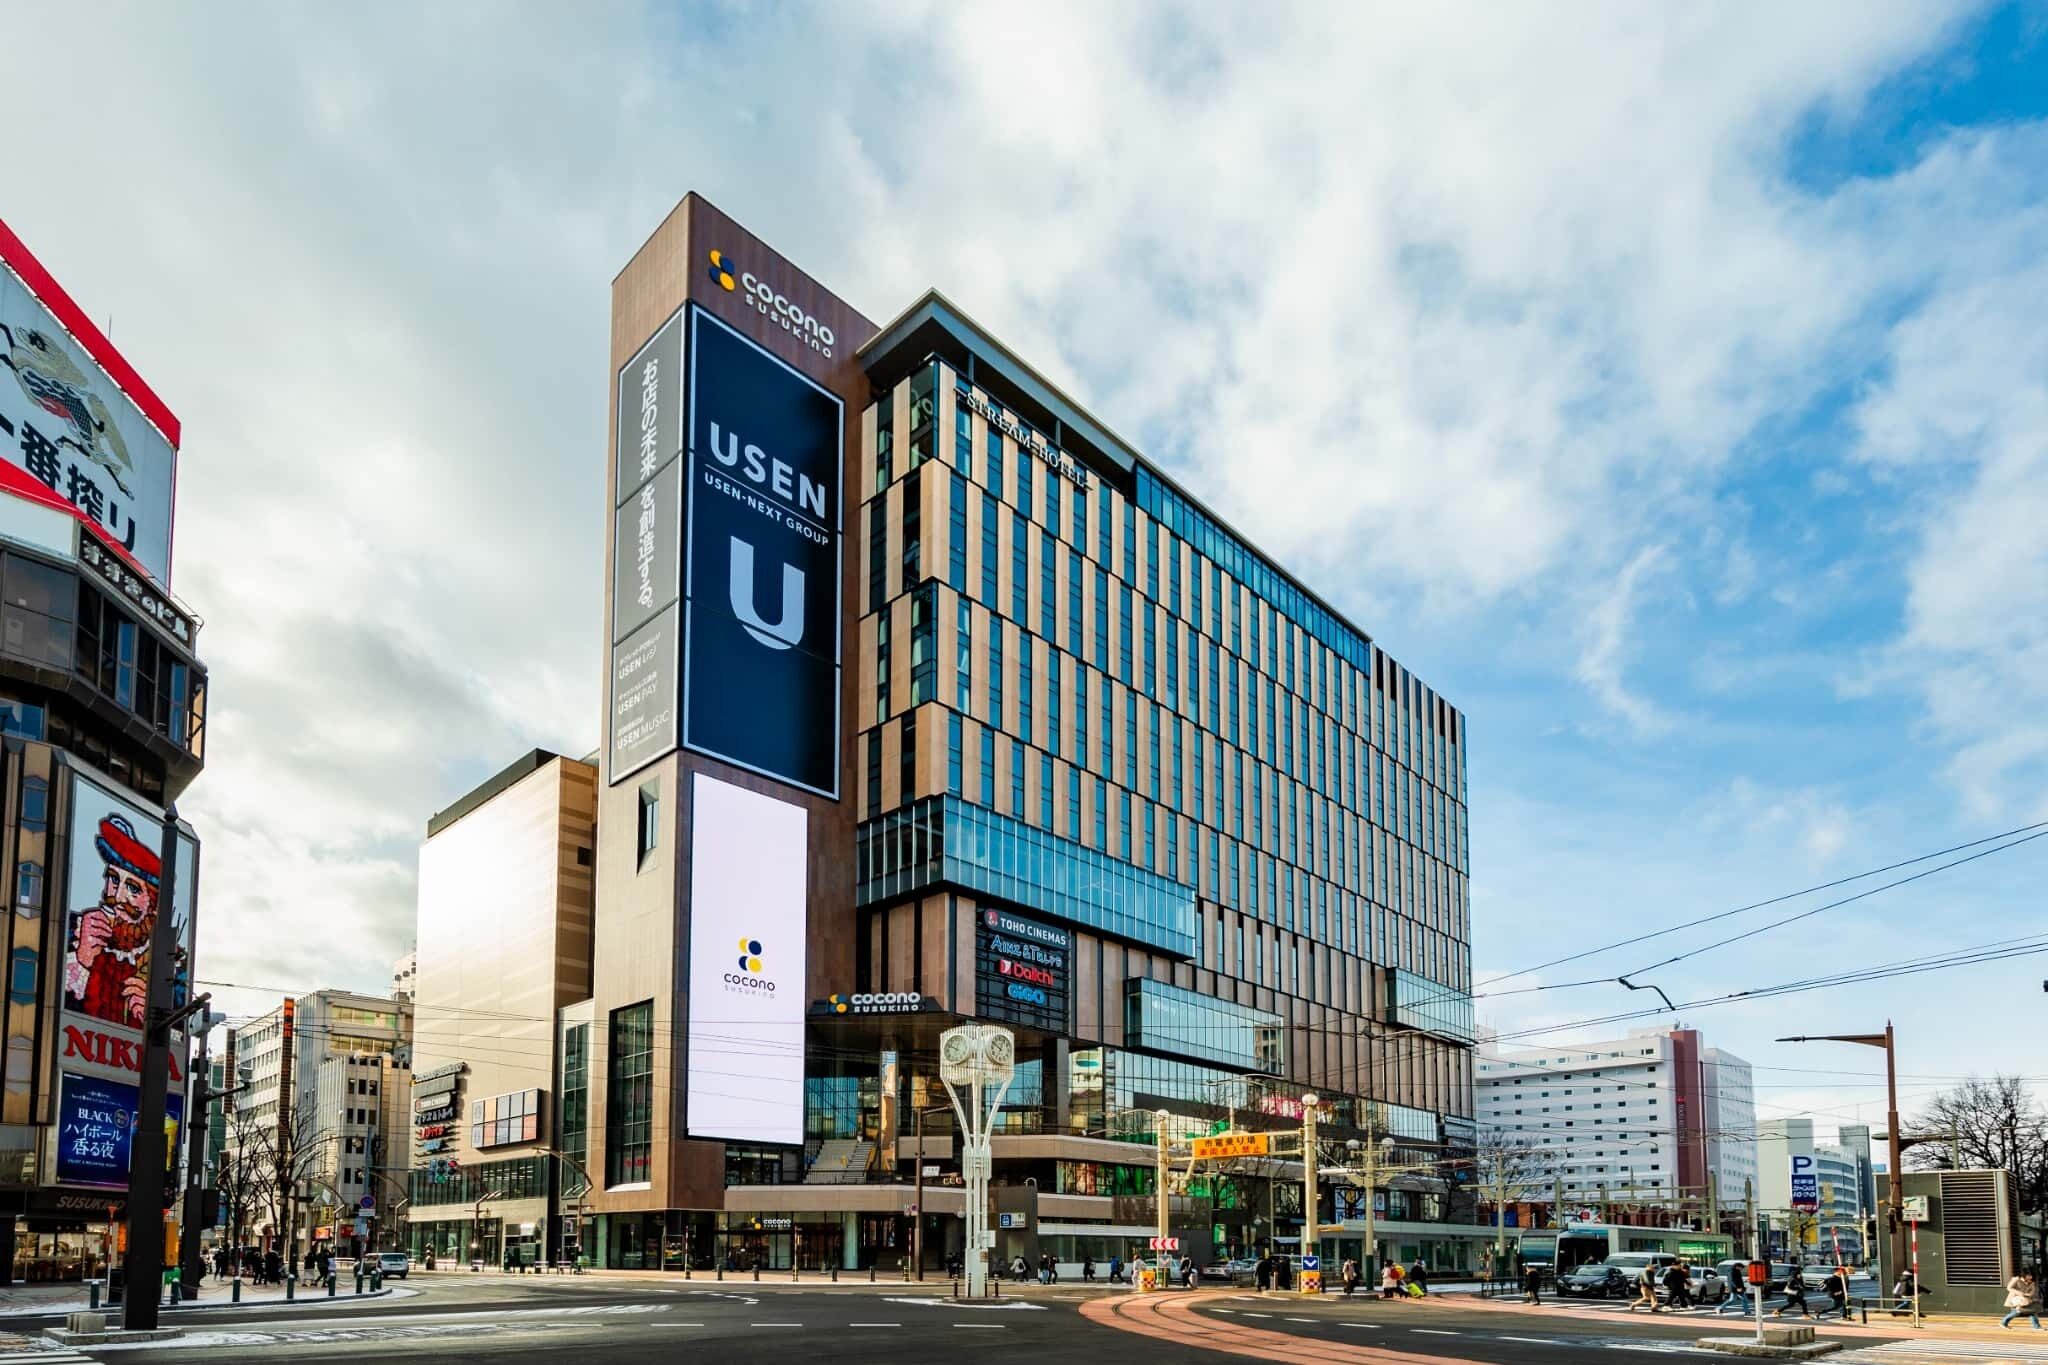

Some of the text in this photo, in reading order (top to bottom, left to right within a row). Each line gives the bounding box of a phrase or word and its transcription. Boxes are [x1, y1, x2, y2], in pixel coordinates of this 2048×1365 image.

[741, 272, 835, 346] cocono
[966, 392, 1031, 450] STREAM
[1038, 447, 1085, 488] HOTEL
[710, 420, 828, 520] USEN
[704, 471, 829, 547] USEN-NEXT GROUP
[618, 656, 642, 679] USEN
[617, 692, 641, 715] USEN
[616, 727, 640, 750] USEN
[1000, 917, 1067, 946] TOHO CINEMAS
[723, 972, 776, 992] cocono
[851, 991, 921, 1005] cocono
[63, 1024, 183, 1082] NIKA
[77, 1107, 113, 1124] BLACK
[64, 1123, 123, 1142] ハイボール
[72, 1138, 116, 1160] 香る夜
[1793, 1156, 1812, 1174] P
